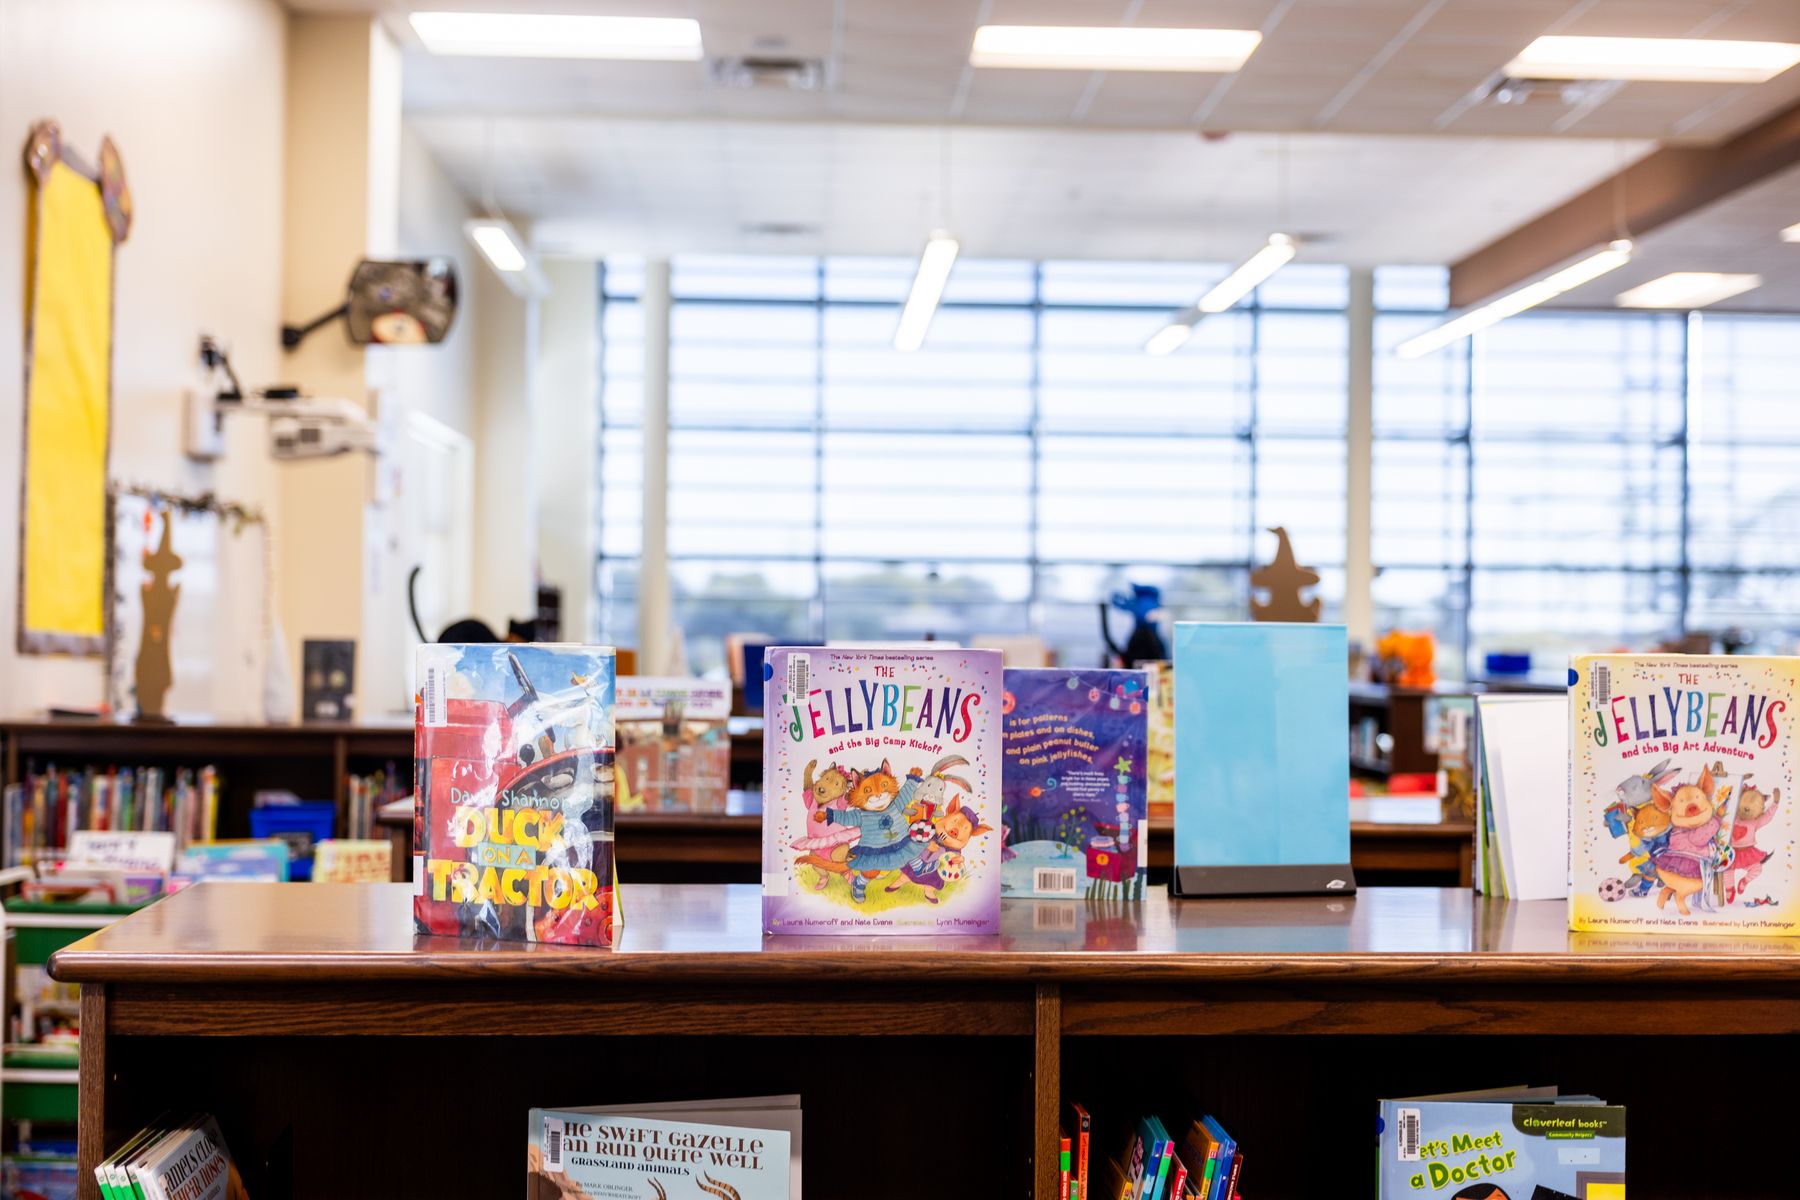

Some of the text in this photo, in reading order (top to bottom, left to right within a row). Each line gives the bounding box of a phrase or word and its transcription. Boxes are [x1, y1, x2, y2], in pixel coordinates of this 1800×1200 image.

[885, 654, 915, 662] bestselling
[874, 666, 896, 678] THE
[1678, 673, 1700, 685] THE
[782, 680, 981, 743] JELLYBEANS
[1019, 716, 1031, 726] for
[1032, 714, 1068, 726] patterns
[1587, 687, 1787, 749] JELLYBEANS
[1010, 729, 1035, 740] plates
[1036, 726, 1052, 735] and
[828, 736, 943, 755] and the Big Camp Kickoff
[1006, 738, 1099, 756] and plain peanut butter
[1622, 741, 1755, 761] and the Big Art Adventure
[1032, 756, 1048, 766] pink
[450, 787, 496, 804] Dav
[454, 806, 566, 853] DUCK
[482, 846, 534, 866] ON A
[427, 858, 600, 912] TRACTOR
[783, 918, 803, 926] Laura
[804, 918, 839, 926] Numeroff
[840, 918, 854, 926] and
[854, 918, 871, 926] Nate
[872, 918, 893, 926] Evans
[936, 918, 953, 927] Lynn
[954, 918, 990, 928] Munsinger
[1742, 920, 1758, 928] Lynn
[1760, 920, 1795, 929] Munsinger
[564, 1122, 592, 1137] He
[1523, 1117, 1576, 1129] cloverleaf
[563, 1138, 589, 1153] an
[1420, 1131, 1503, 1160] et's Meet
[164, 1149, 198, 1192] ameLs
[1410, 1149, 1517, 1190] a Doctor
